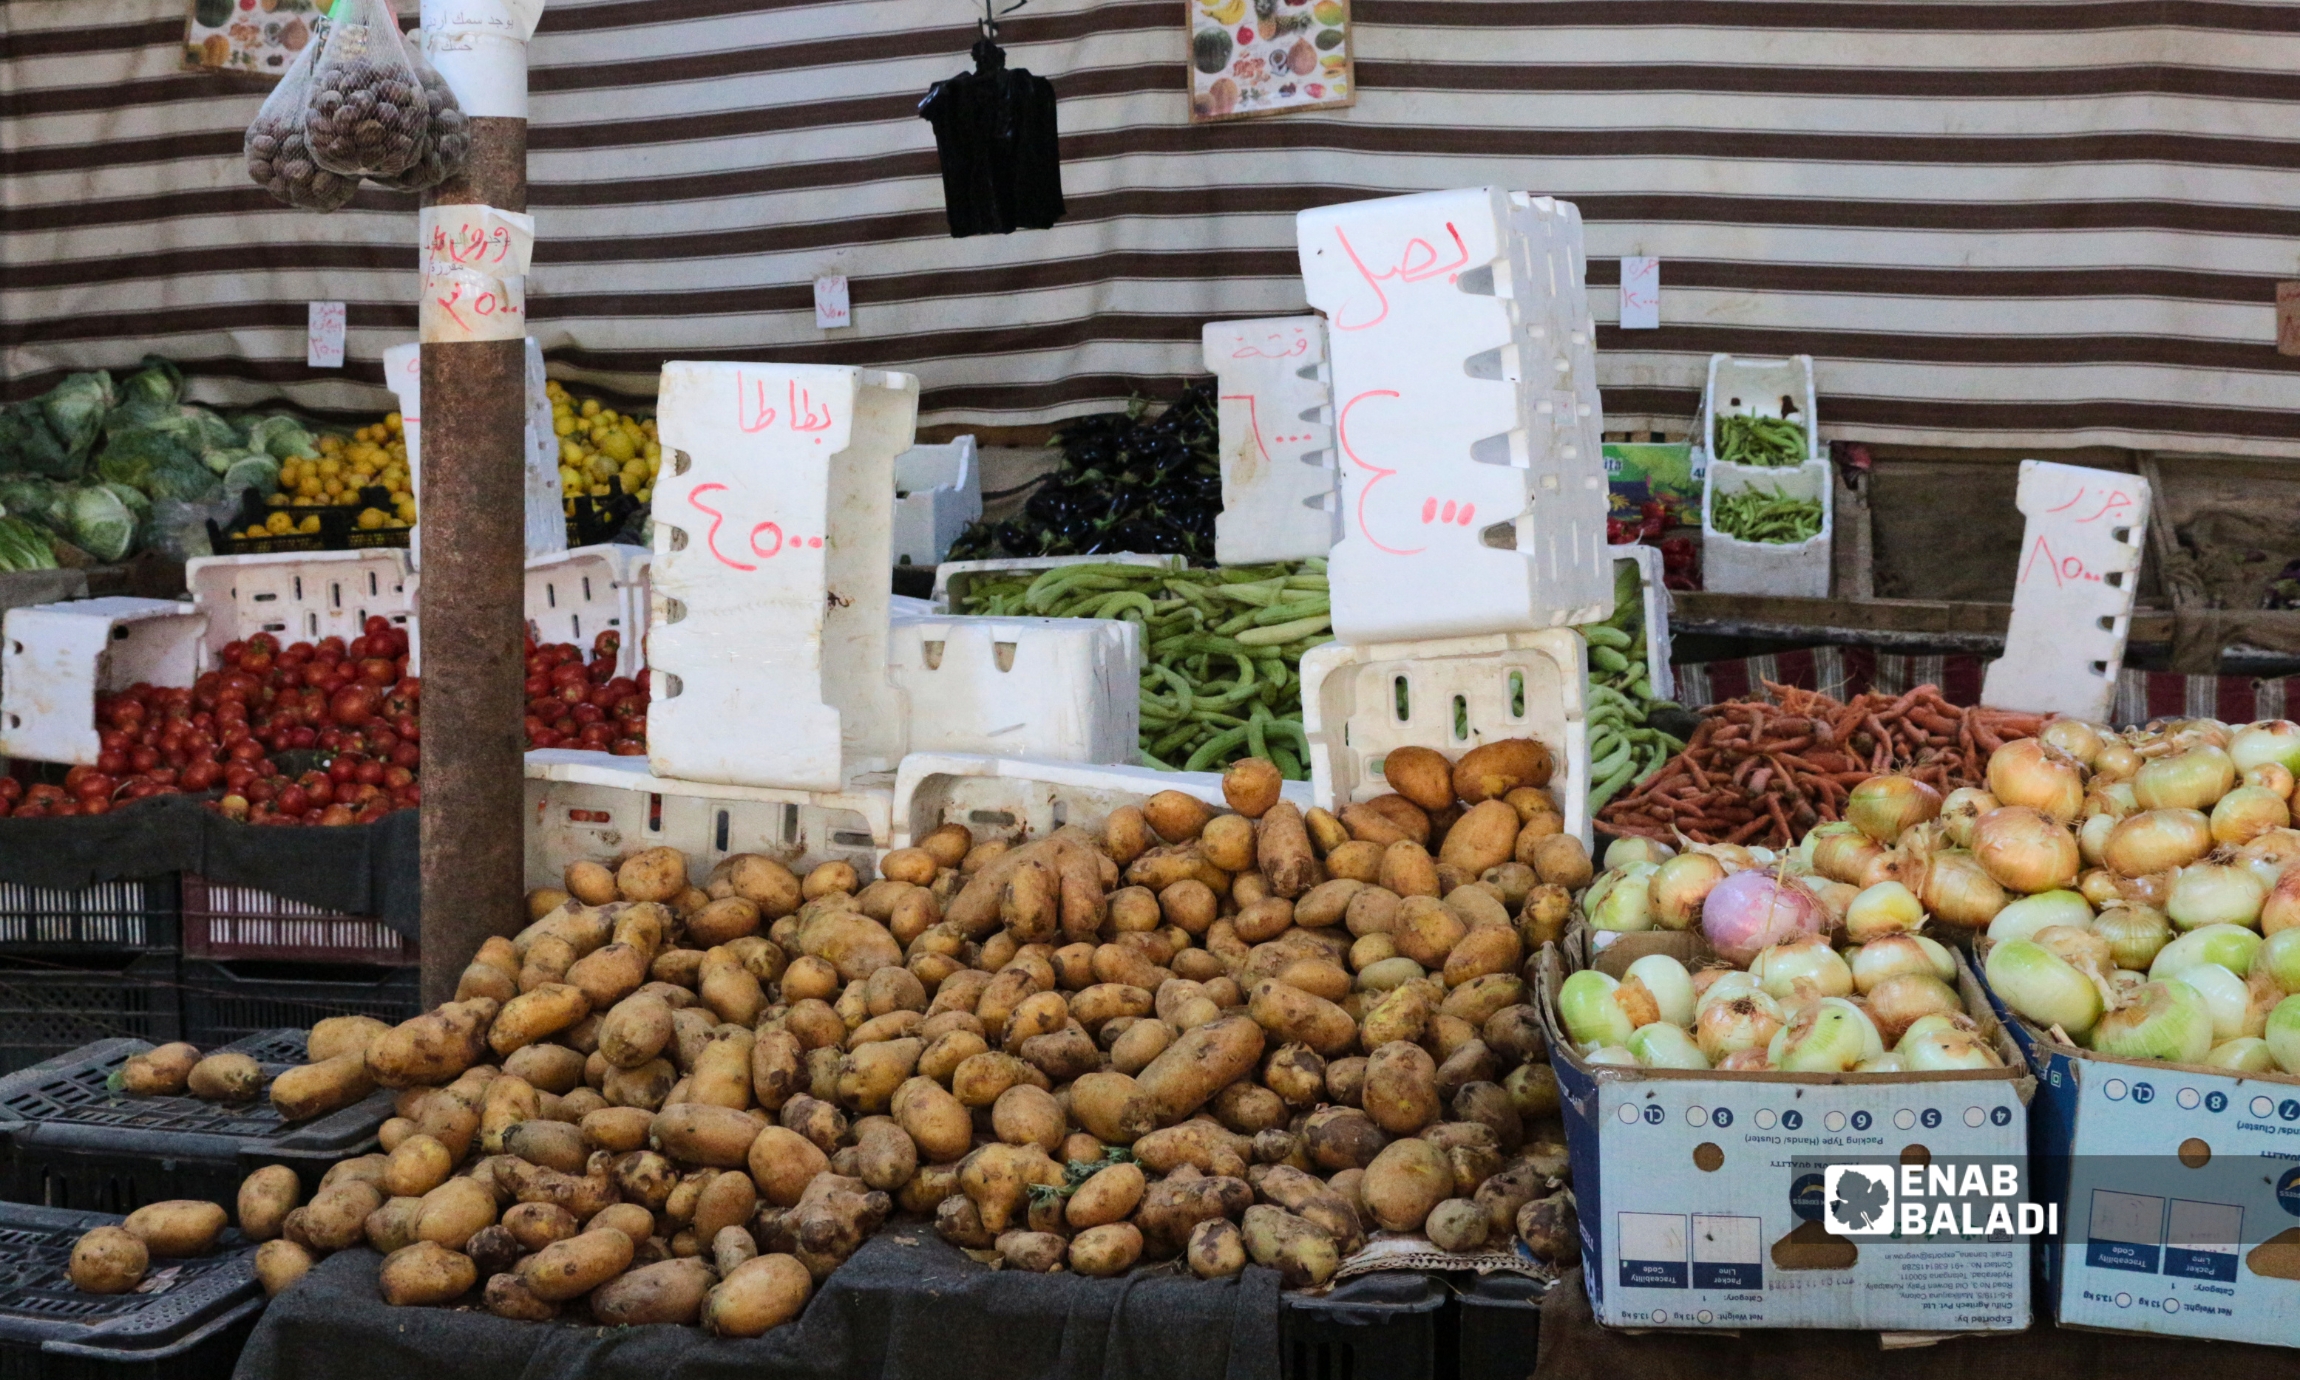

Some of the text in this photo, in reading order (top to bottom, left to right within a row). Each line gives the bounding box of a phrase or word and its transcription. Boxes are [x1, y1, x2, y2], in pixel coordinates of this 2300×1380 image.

[452, 12, 483, 25] سمك
[488, 16, 515, 30] يوجد
[1334, 221, 1469, 332] بصل
[1220, 394, 1312, 462] ٦٠٠٠
[1339, 389, 1476, 556] ٤٠٠٠
[2046, 485, 2133, 524] جزر
[687, 482, 824, 572] ٤٥٠٠
[2021, 534, 2102, 590] ٨٥٠٠
[2134, 1086, 2152, 1101] CL
[2211, 1096, 2222, 1110] 8
[1645, 1108, 1664, 1121] CL
[2284, 1104, 2295, 1117] 7
[1717, 1111, 1728, 1125] 8
[1788, 1114, 1798, 1127] 7
[1856, 1114, 1868, 1128] 6
[1926, 1113, 1936, 1126] 5
[1996, 1110, 2006, 1124] 4
[2236, 1121, 2276, 1135] Cluster)
[1744, 1134, 1884, 1146] Packing Type (Hands/ Cluster)
[1770, 1160, 1811, 1169] QUALITY
[2112, 1246, 2135, 1256] Code
[1950, 1262, 1964, 1270] +91
[2098, 1254, 2147, 1268] Traceability
[2192, 1256, 2211, 1265] Line
[1642, 1266, 1664, 1274] Code
[1718, 1268, 1736, 1276] Line
[2186, 1264, 2215, 1275] Packer
[1630, 1274, 1676, 1284] Traceability
[1713, 1276, 1742, 1285] Packer
[1929, 1272, 1968, 1280] Telangana
[1927, 1282, 1953, 1290] Bowen
[2193, 1284, 2235, 1296] Category:
[1723, 1294, 1764, 1303] Category:
[2082, 1291, 2113, 1303] 13.5 kg
[1920, 1302, 1936, 1310] Ltd.
[1938, 1302, 1954, 1310] Pvt.
[1955, 1300, 1990, 1310] Agritech
[2138, 1298, 2161, 1309] 13 kg
[2183, 1303, 2233, 1316] Net Weight:
[1621, 1310, 1650, 1320] 13.5 kg
[1673, 1312, 1684, 1320] kg
[1716, 1312, 1763, 1321] Net Weight:
[1954, 1314, 2013, 1324] Exported by:
